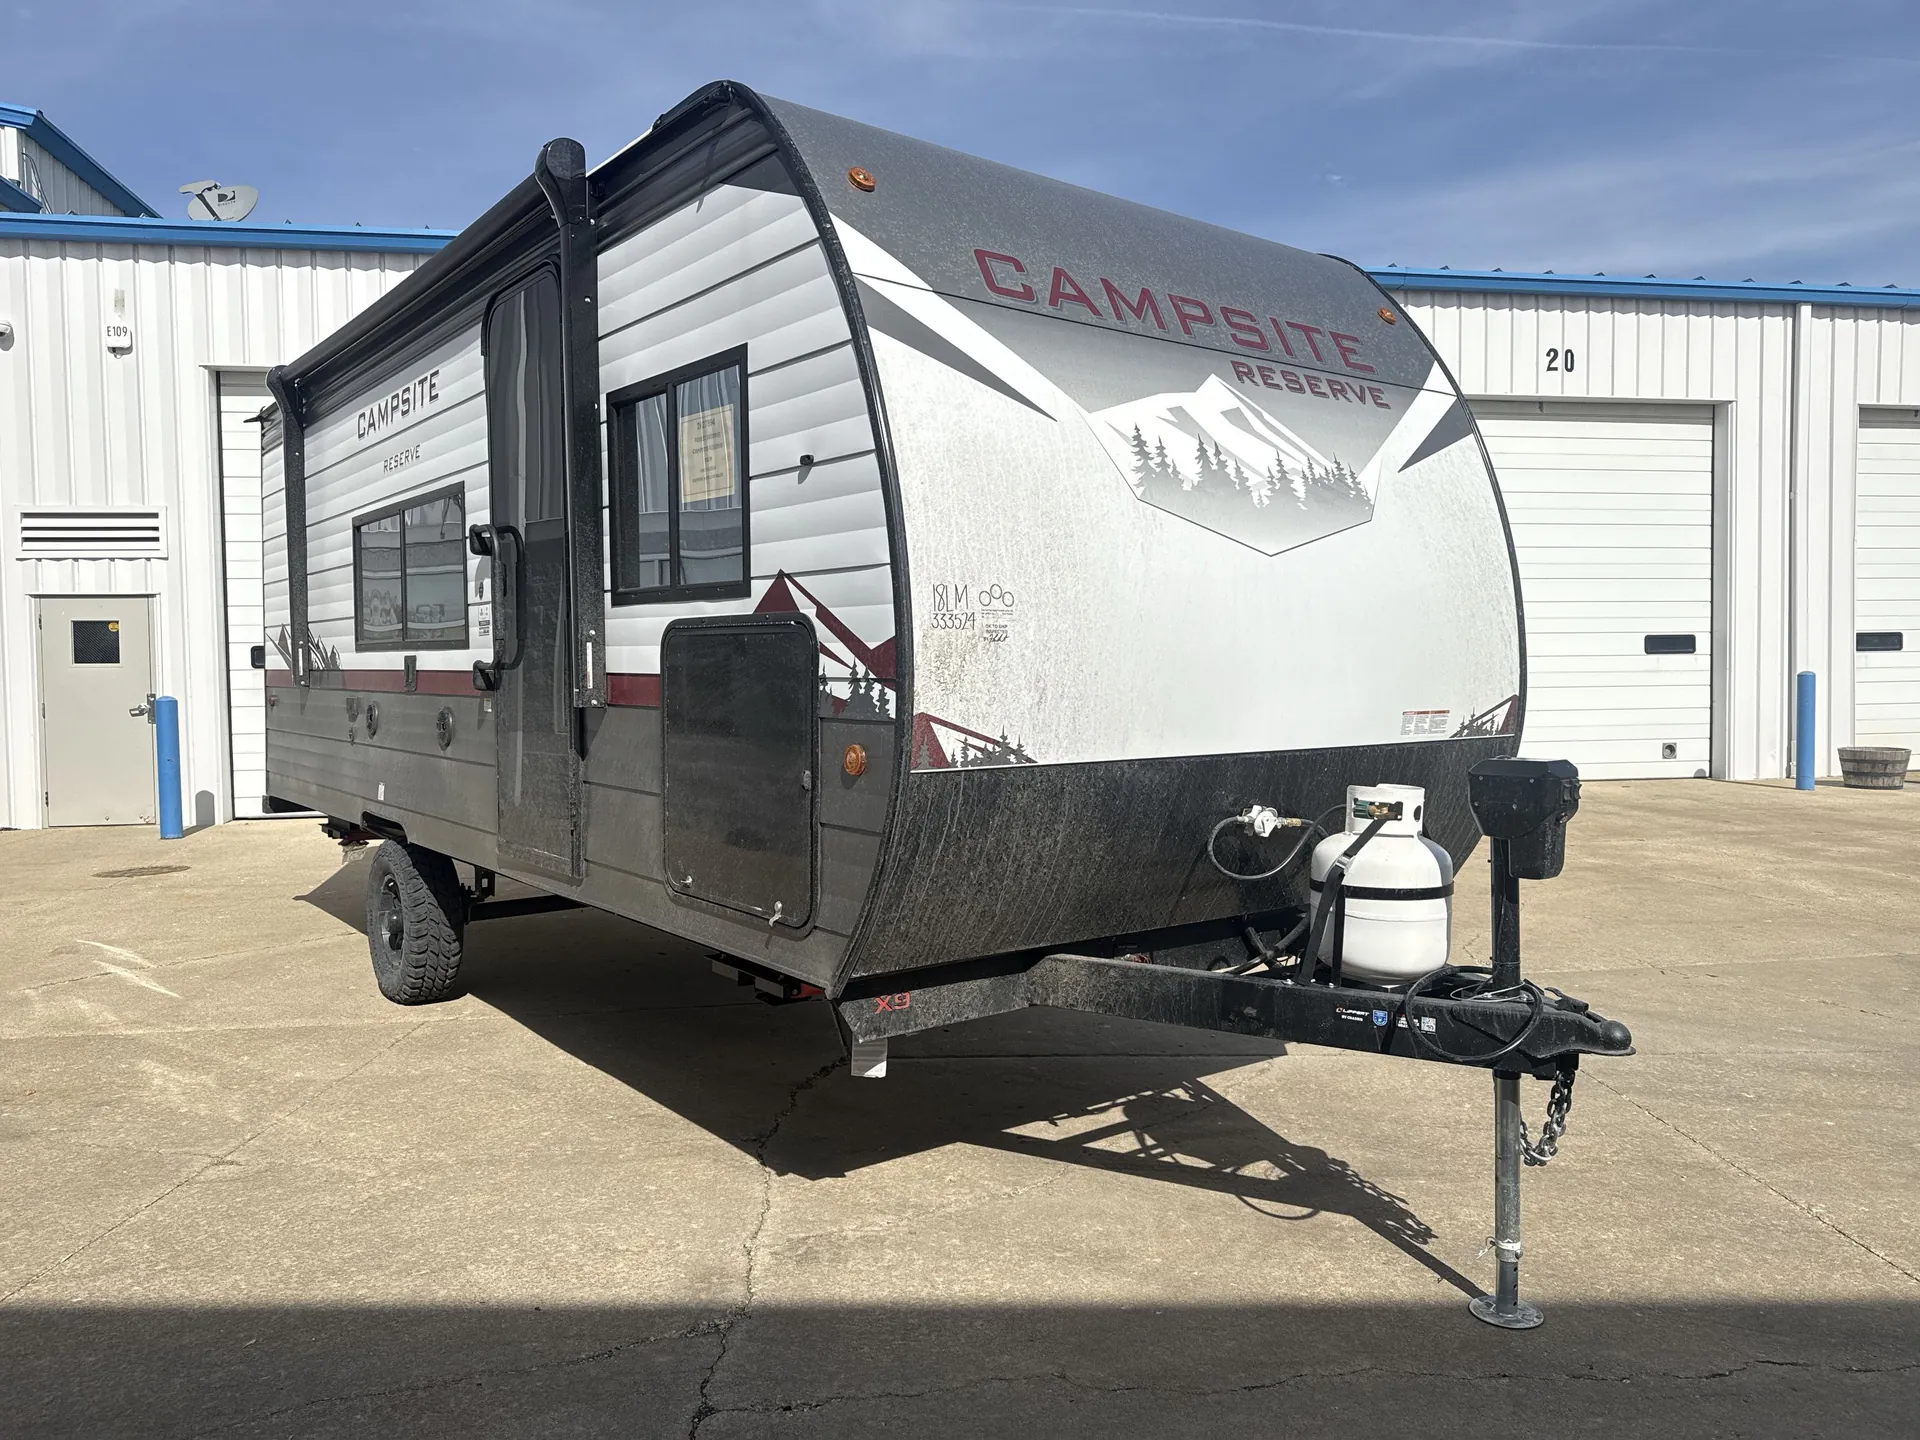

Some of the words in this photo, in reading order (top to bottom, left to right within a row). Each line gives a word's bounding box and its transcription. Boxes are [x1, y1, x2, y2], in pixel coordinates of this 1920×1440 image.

[973, 247, 1378, 374] CAMPSITE
[106, 325, 128, 337] E109
[1545, 347, 1575, 373] 20
[1229, 359, 1392, 410] RESERVE
[357, 368, 440, 441] CAMPSITE
[383, 443, 421, 474] RESERVE
[931, 611, 976, 631] 333524
[874, 991, 911, 1014] X9
